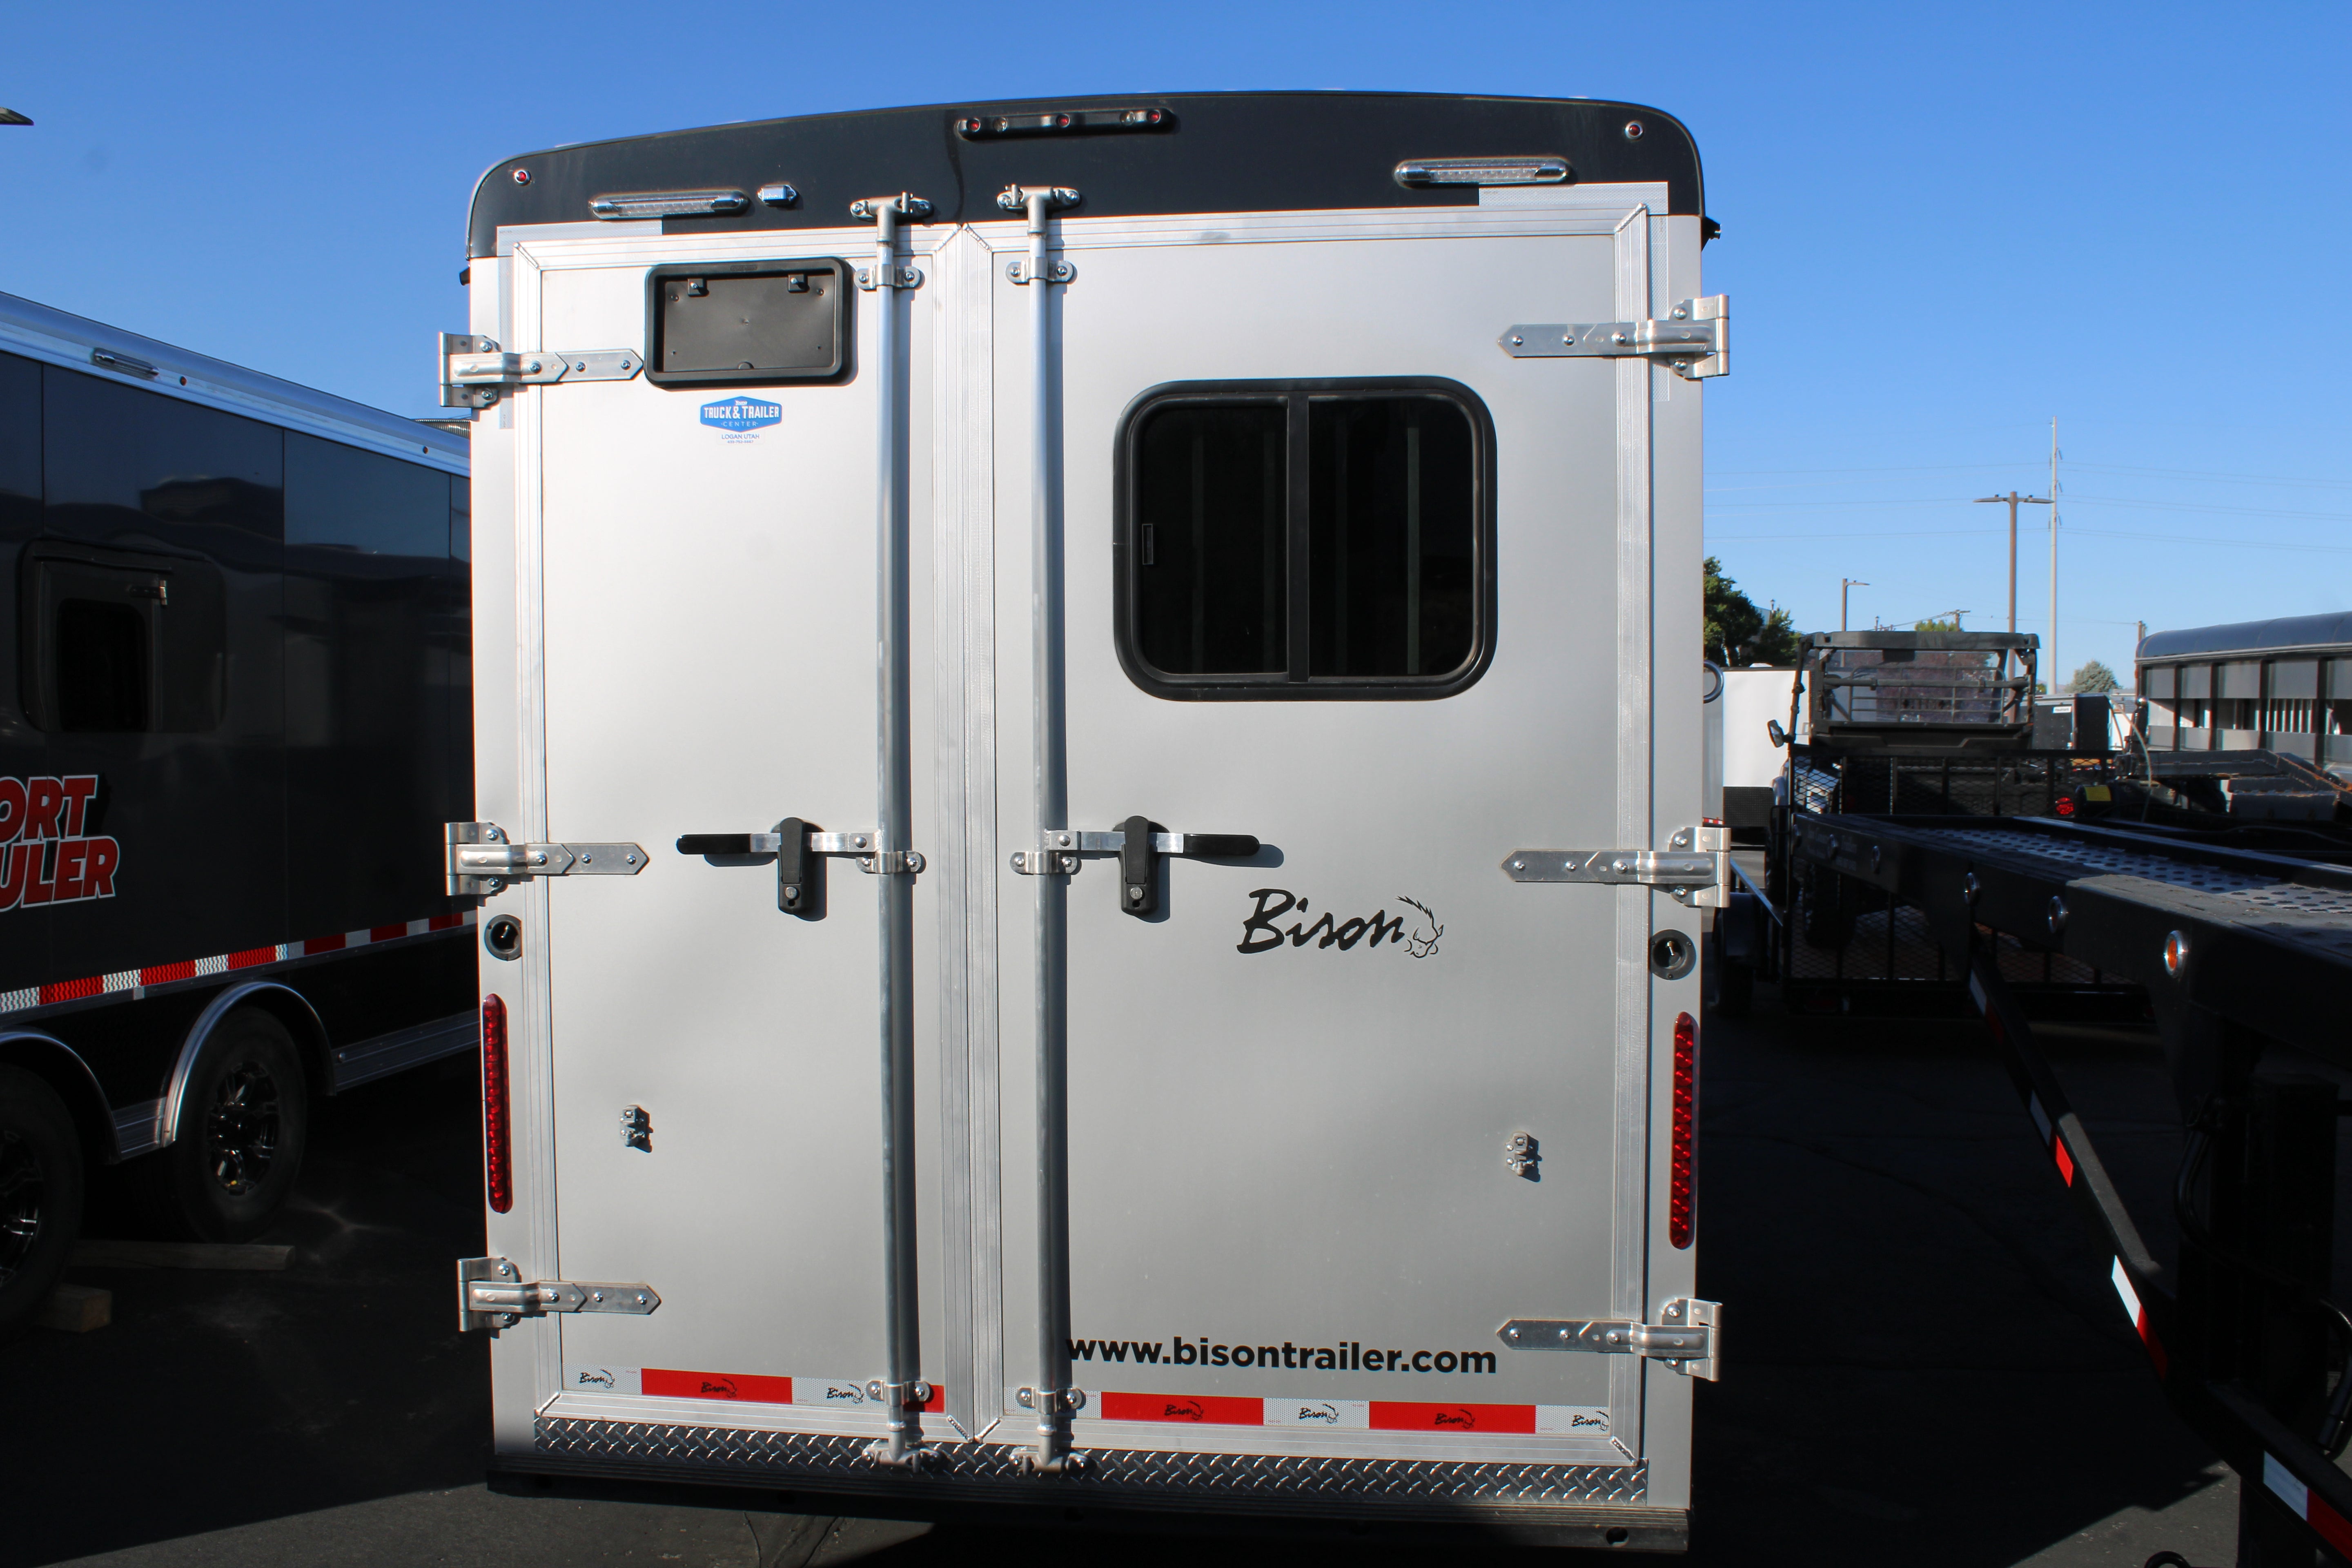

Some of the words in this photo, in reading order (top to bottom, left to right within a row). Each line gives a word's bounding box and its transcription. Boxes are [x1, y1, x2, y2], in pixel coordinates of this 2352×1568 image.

[704, 407, 731, 419] TRUCK
[733, 406, 741, 419] &
[742, 406, 779, 419] TRAILER
[1236, 888, 1405, 954] Bison
[1065, 1336, 1496, 1374] www.bisontrailer.com
